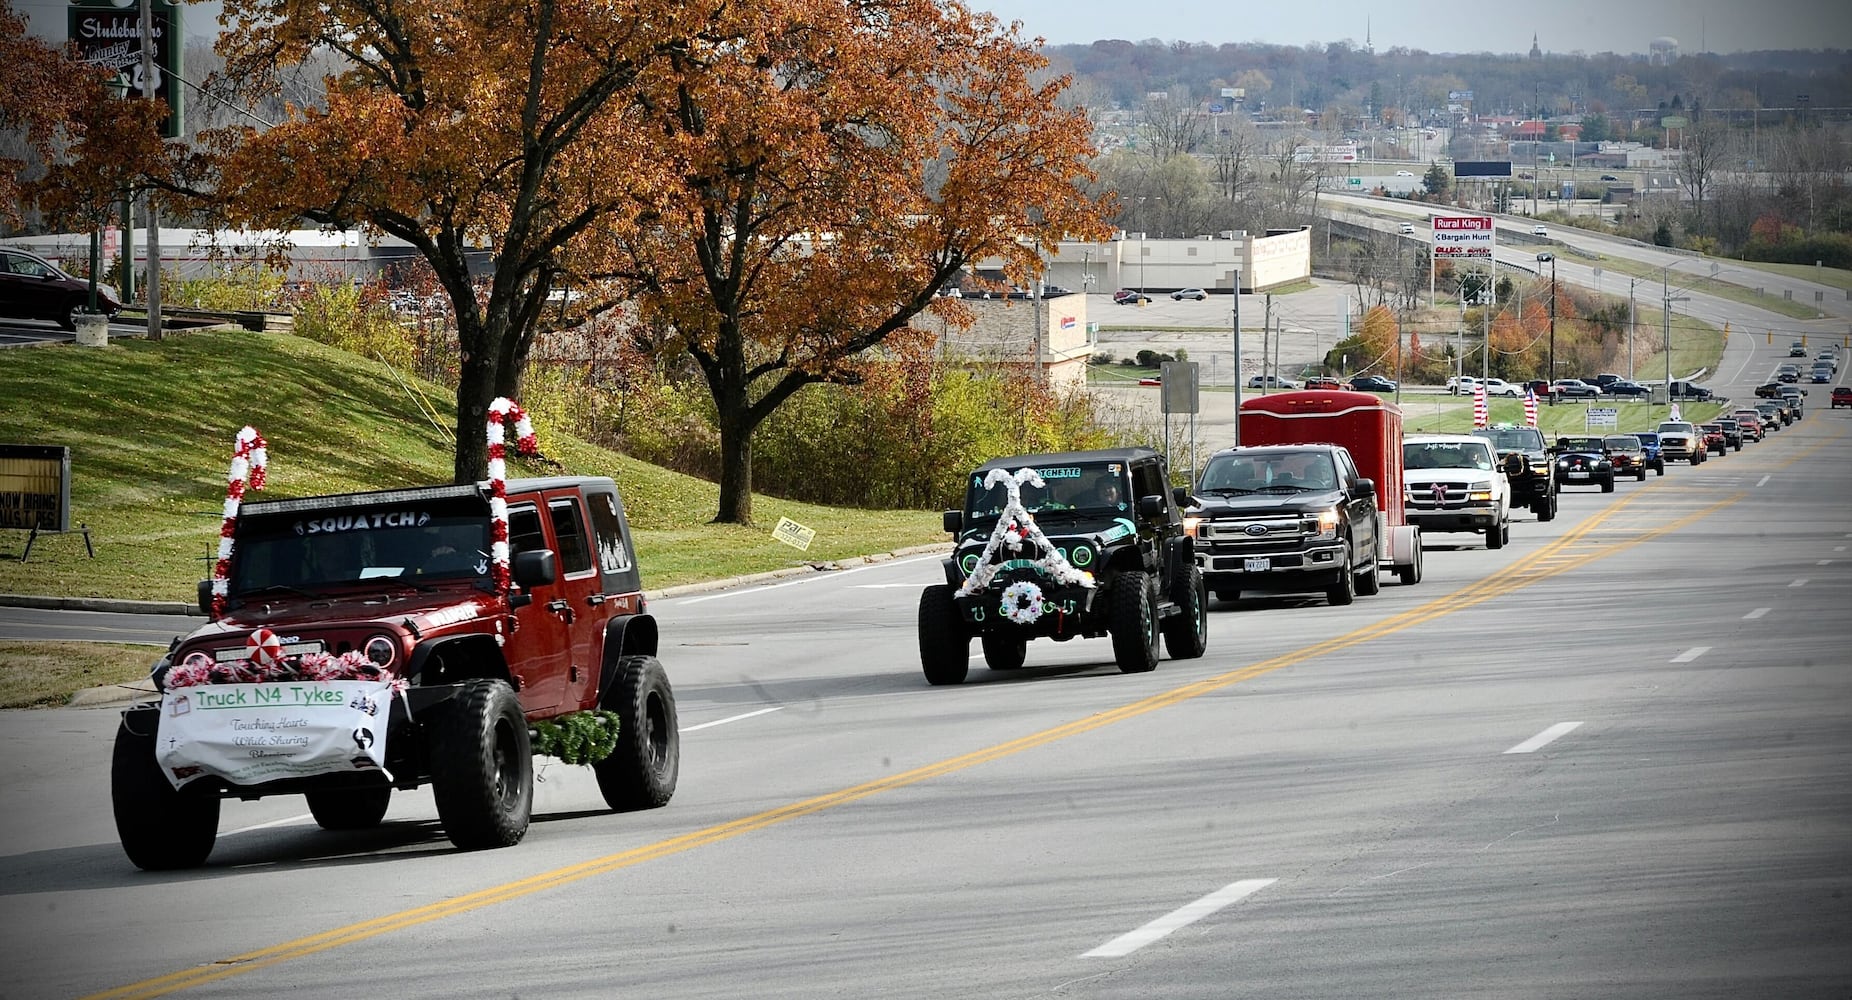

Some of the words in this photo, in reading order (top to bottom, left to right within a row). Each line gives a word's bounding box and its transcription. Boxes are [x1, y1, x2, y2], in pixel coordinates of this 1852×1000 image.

[1437, 218, 1460, 228] Rural
[1461, 218, 1481, 229] King
[1441, 233, 1471, 242] Bargain
[1472, 233, 1490, 241] Hunt
[307, 511, 416, 533] SQUATCH
[196, 689, 246, 706] Truck
[255, 687, 282, 704] N4
[290, 686, 344, 707] Tykes
[230, 718, 275, 731] Touching
[274, 717, 308, 730] Hearts
[268, 735, 309, 747] Sharing
